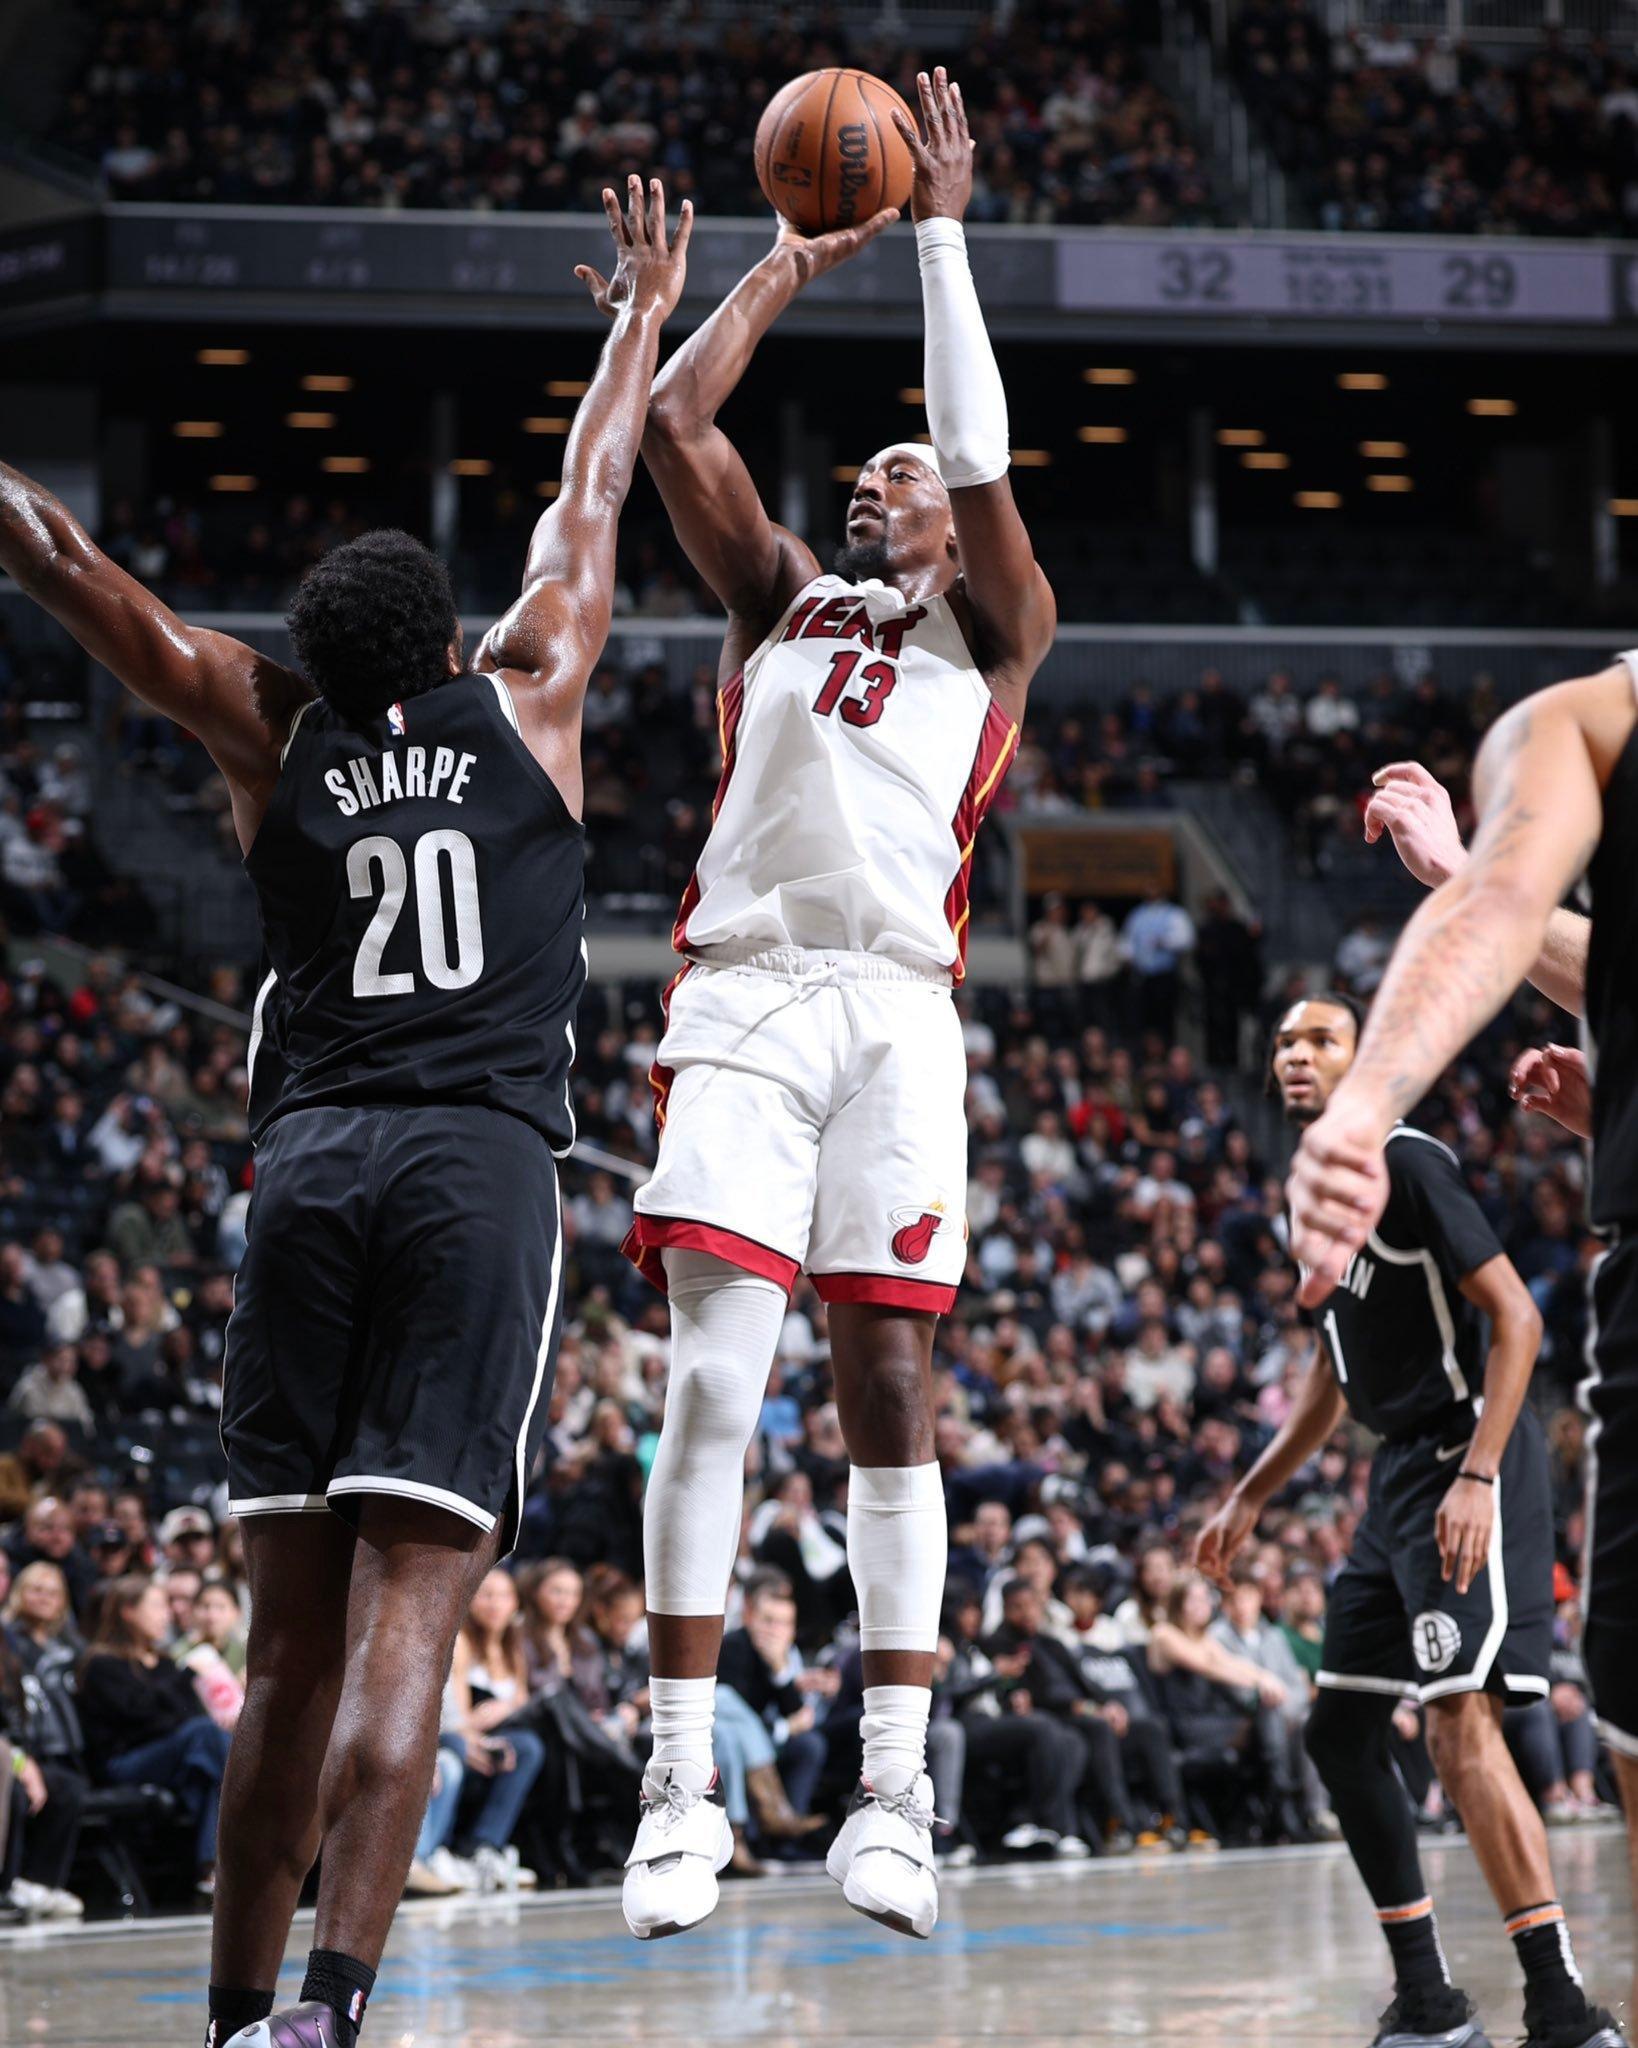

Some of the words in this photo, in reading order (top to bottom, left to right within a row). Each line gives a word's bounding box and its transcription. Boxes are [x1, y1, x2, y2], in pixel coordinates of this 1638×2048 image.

[1157, 249, 1234, 301] 32
[1442, 256, 1518, 310] 29
[811, 650, 897, 728] 13
[323, 745, 478, 817] SHARPE
[346, 828, 484, 998] 20
[1323, 1307, 1349, 1385] 1
[1424, 1619, 1443, 1664] B
